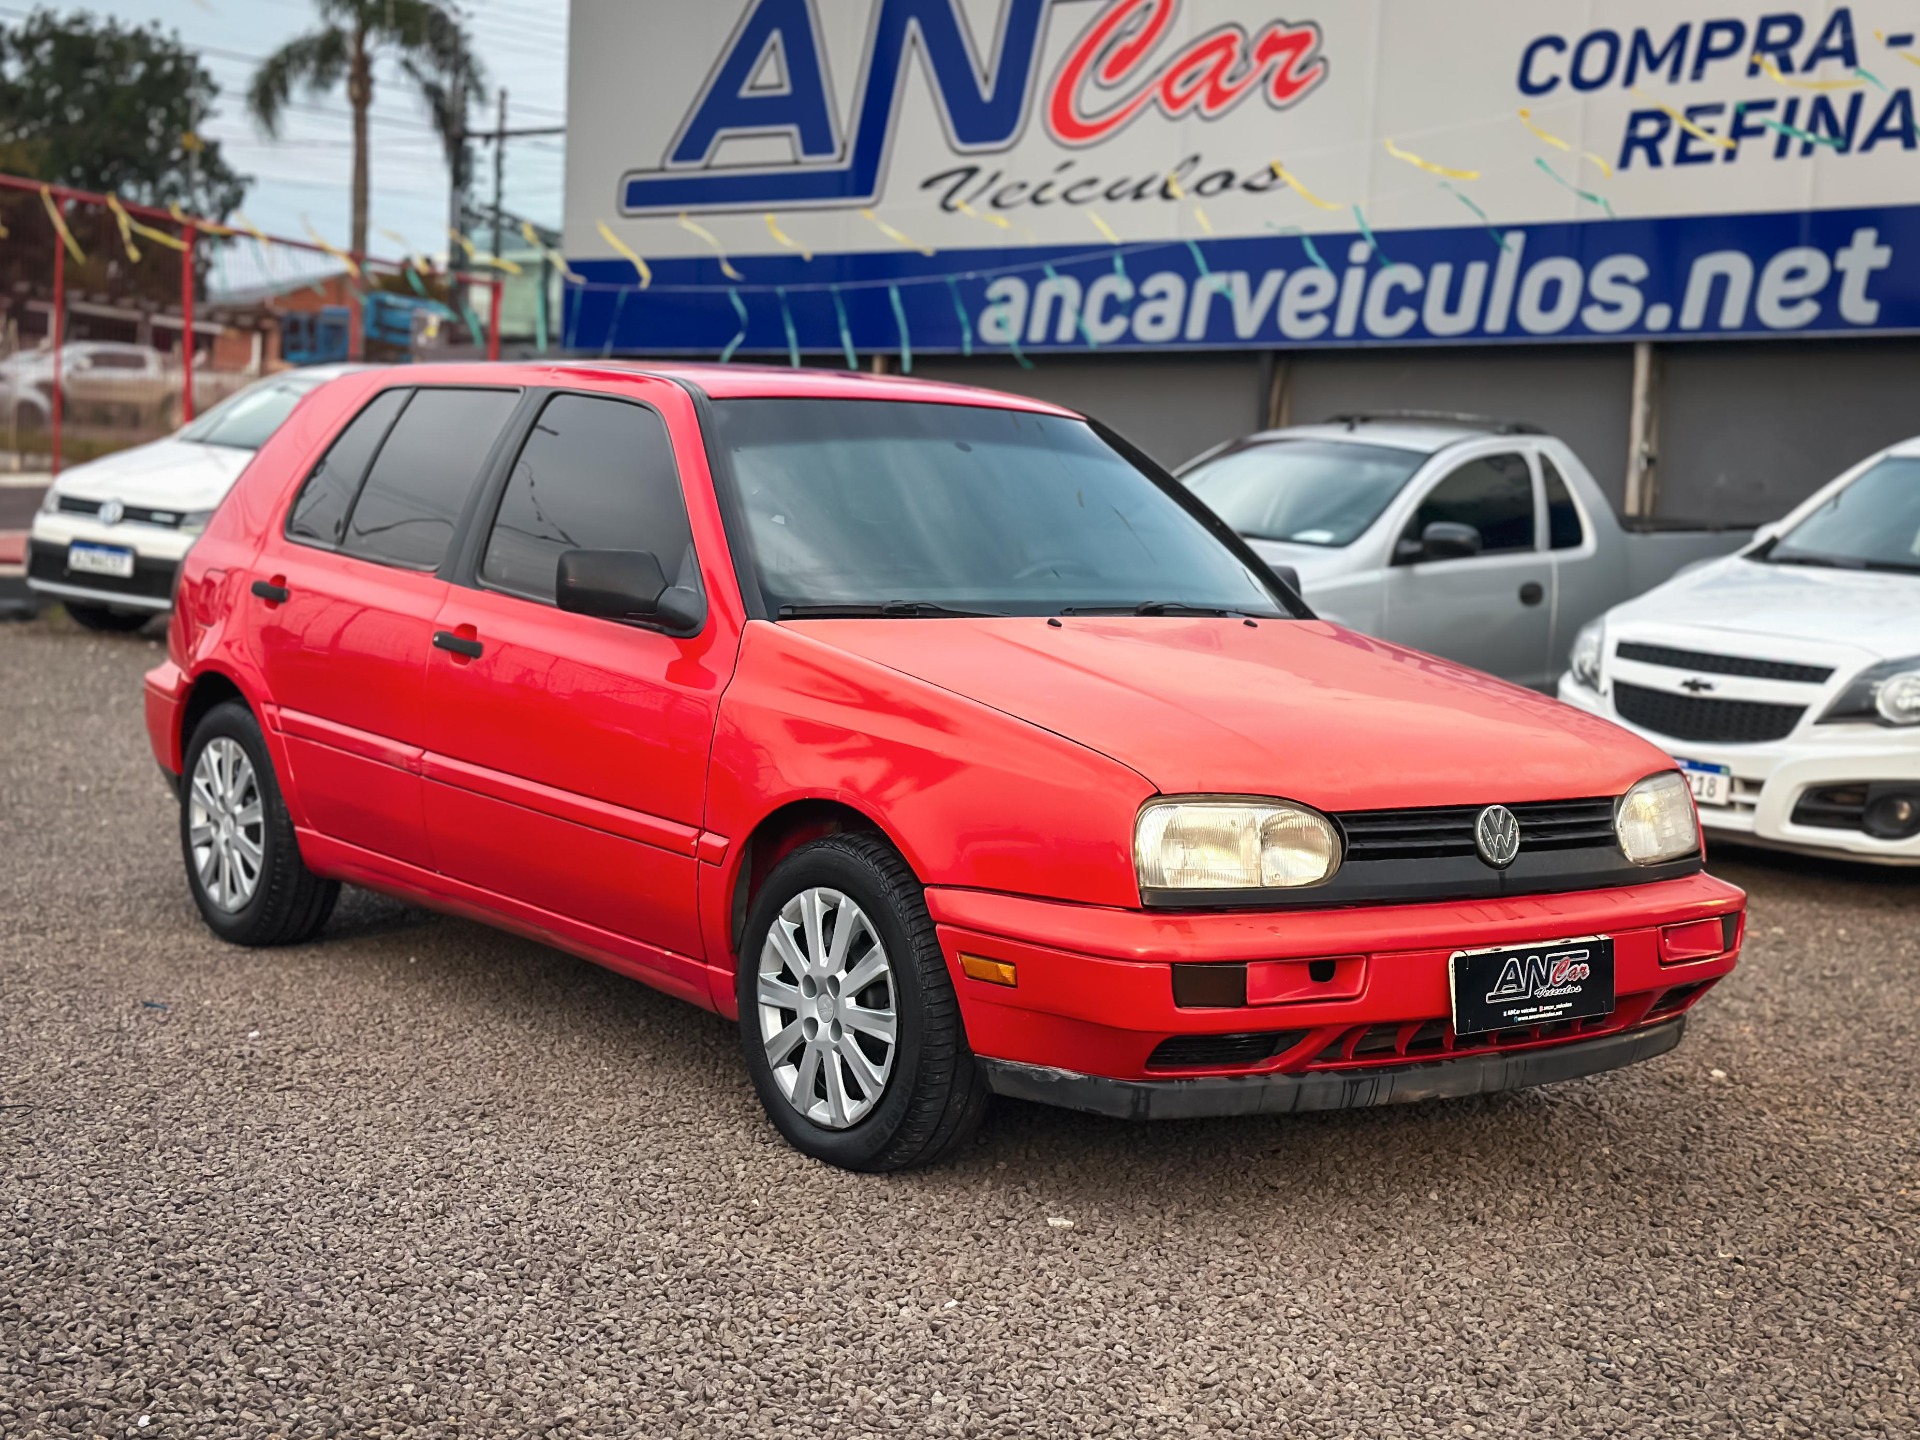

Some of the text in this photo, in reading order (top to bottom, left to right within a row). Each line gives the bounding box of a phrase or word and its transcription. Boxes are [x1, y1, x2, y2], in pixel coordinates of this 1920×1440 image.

[1516, 7, 1860, 96] COMPRA
[1616, 87, 1918, 171] REFINA
[976, 227, 1893, 343] ancarveiculos.net
